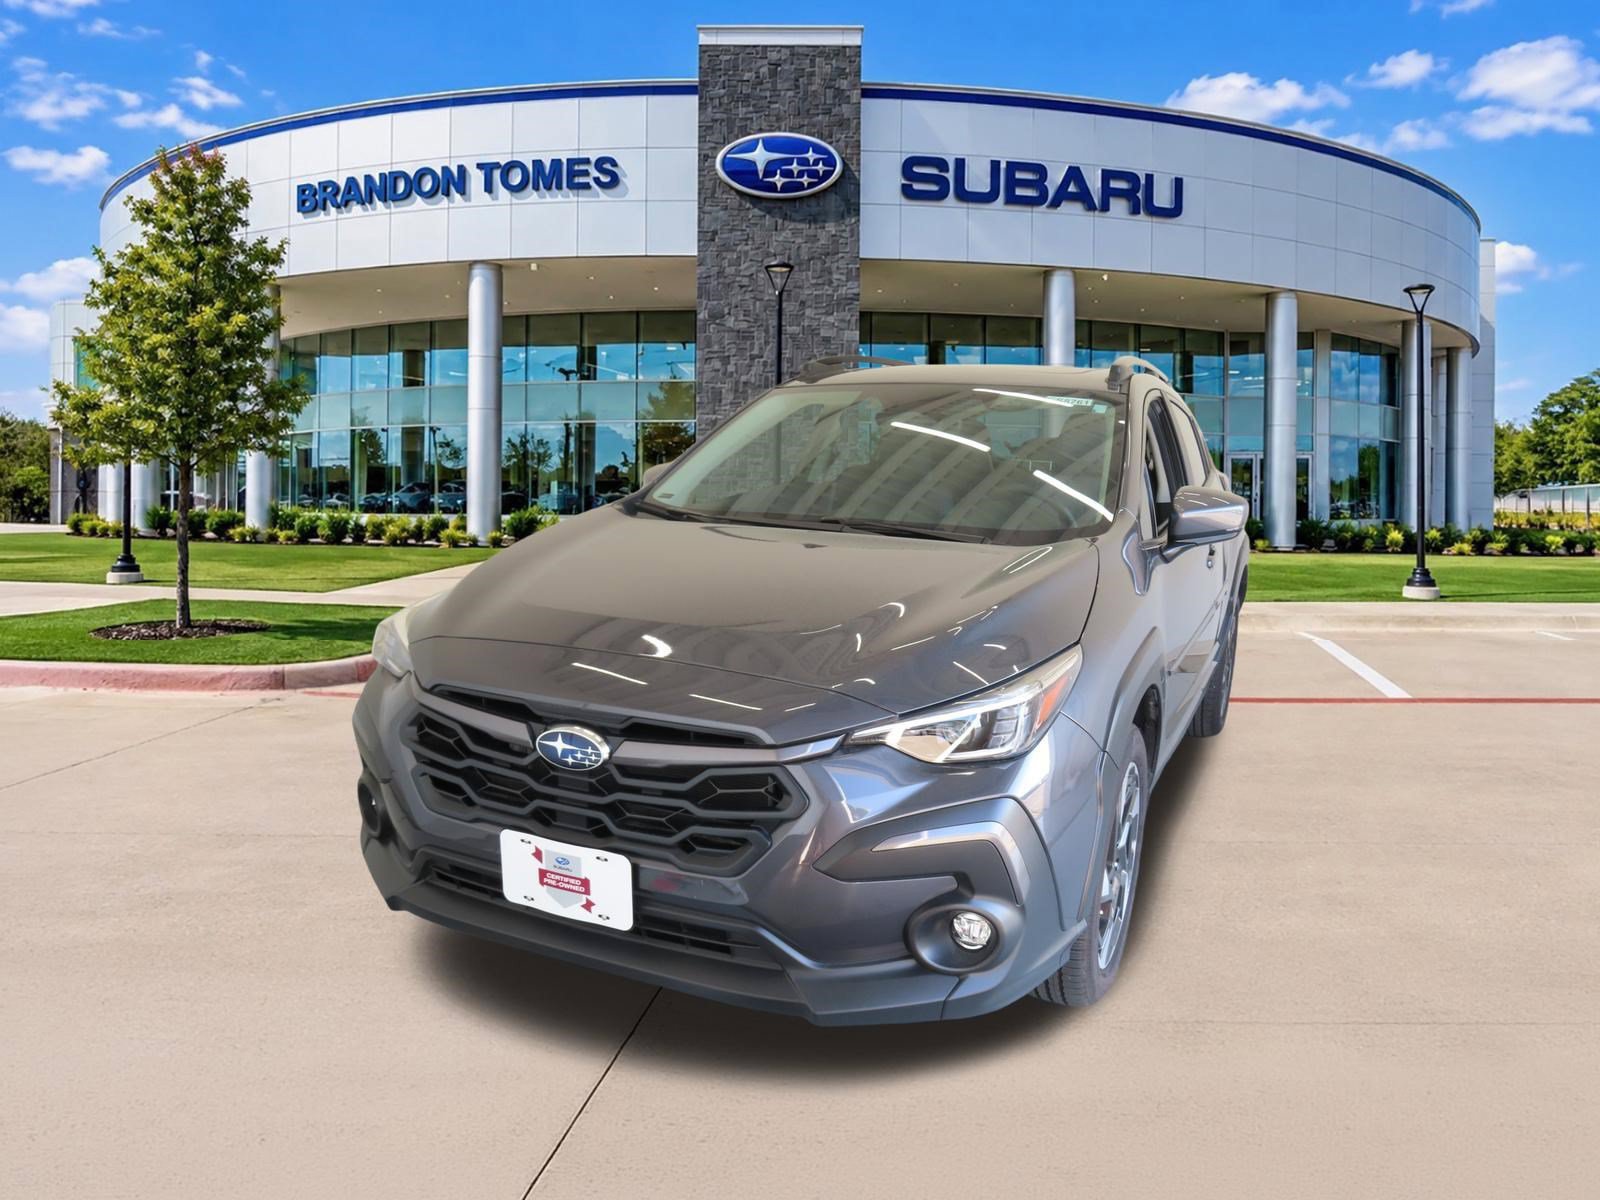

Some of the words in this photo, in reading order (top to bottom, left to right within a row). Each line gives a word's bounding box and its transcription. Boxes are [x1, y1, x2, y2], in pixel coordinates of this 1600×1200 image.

[297, 164, 466, 213] BRANDON
[476, 156, 620, 194] TOMES
[901, 155, 1184, 219] SUBARU
[543, 878, 585, 892] PRE-OWNED
[546, 873, 581, 886] CERTIFIED
